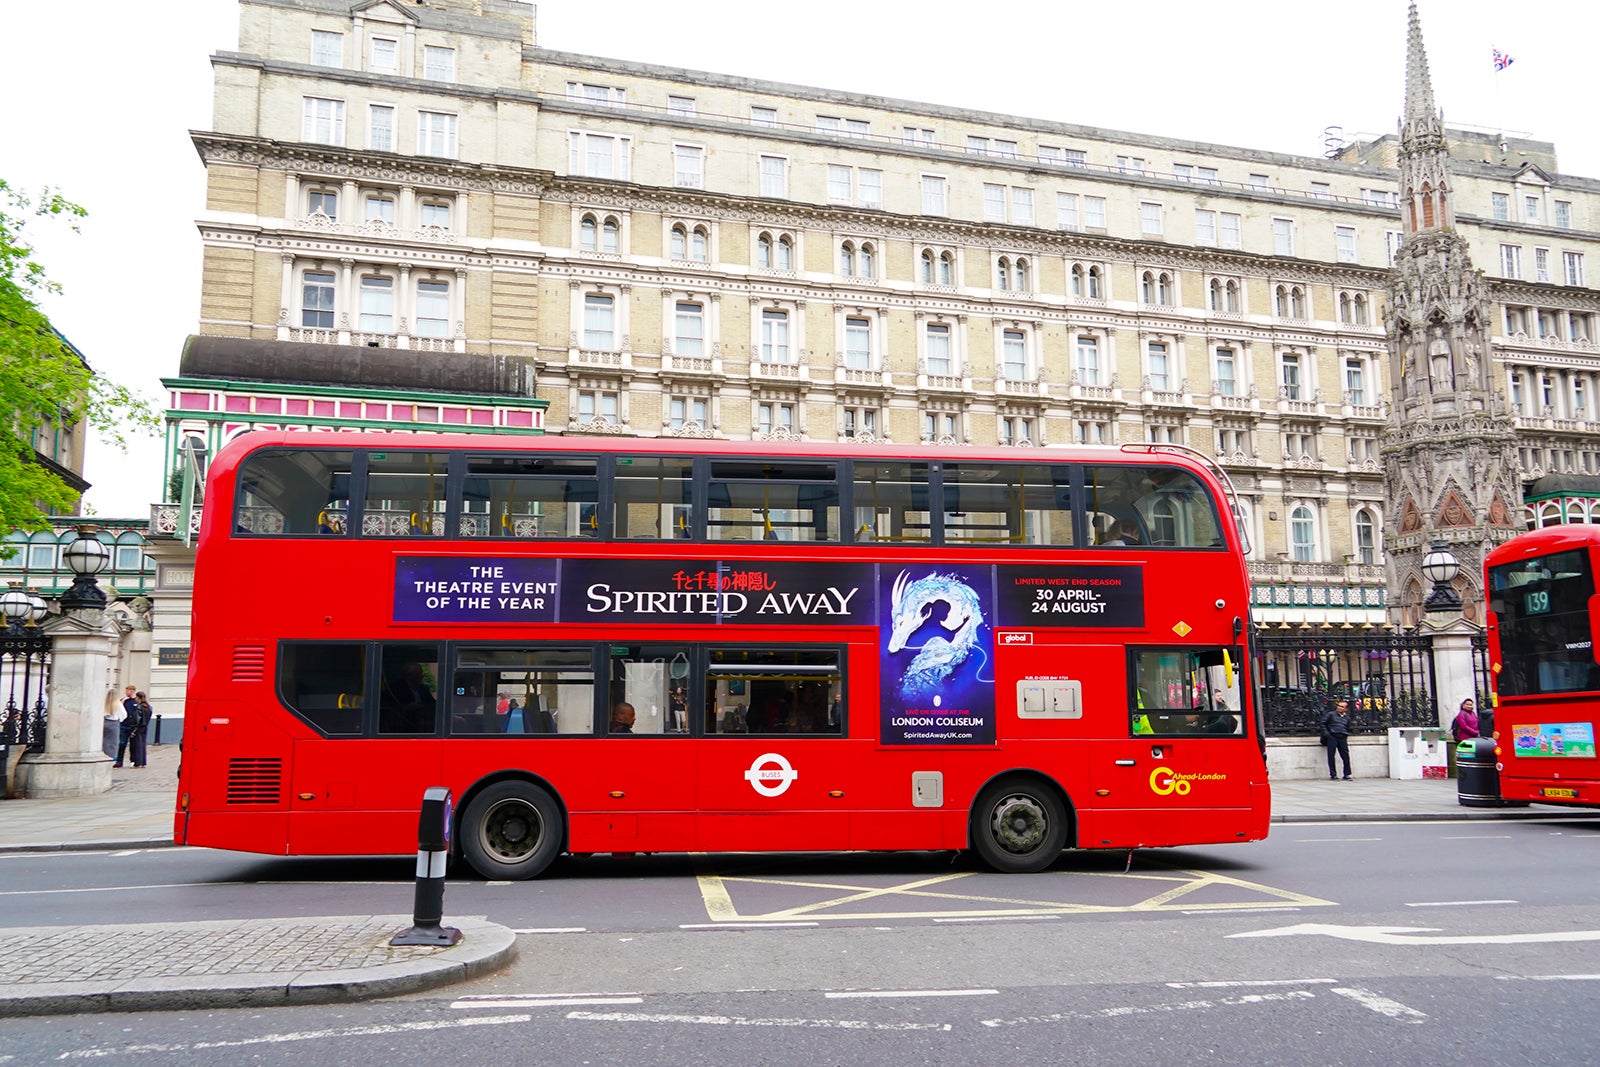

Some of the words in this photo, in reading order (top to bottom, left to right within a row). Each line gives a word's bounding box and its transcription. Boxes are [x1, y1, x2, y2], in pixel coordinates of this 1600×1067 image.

[470, 566, 504, 578] THE
[672, 570, 777, 591] 千と千尋の神隠し
[414, 581, 494, 593] THEATRE
[501, 582, 558, 594] EVENT
[586, 583, 749, 614] SPIRITED
[756, 586, 859, 615] AWAY
[1036, 589, 1054, 600] 30
[1057, 590, 1101, 600] APRIL-
[426, 597, 450, 609] OF
[457, 597, 491, 609] THE
[498, 597, 545, 609] YEAR
[1031, 602, 1048, 613] 24
[1051, 602, 1107, 613] AUGUST
[1527, 591, 1549, 612] 139
[1005, 634, 1027, 644] global
[892, 718, 934, 726] LONDON
[936, 718, 984, 726] COLISEUM
[1149, 767, 1191, 796] Go
